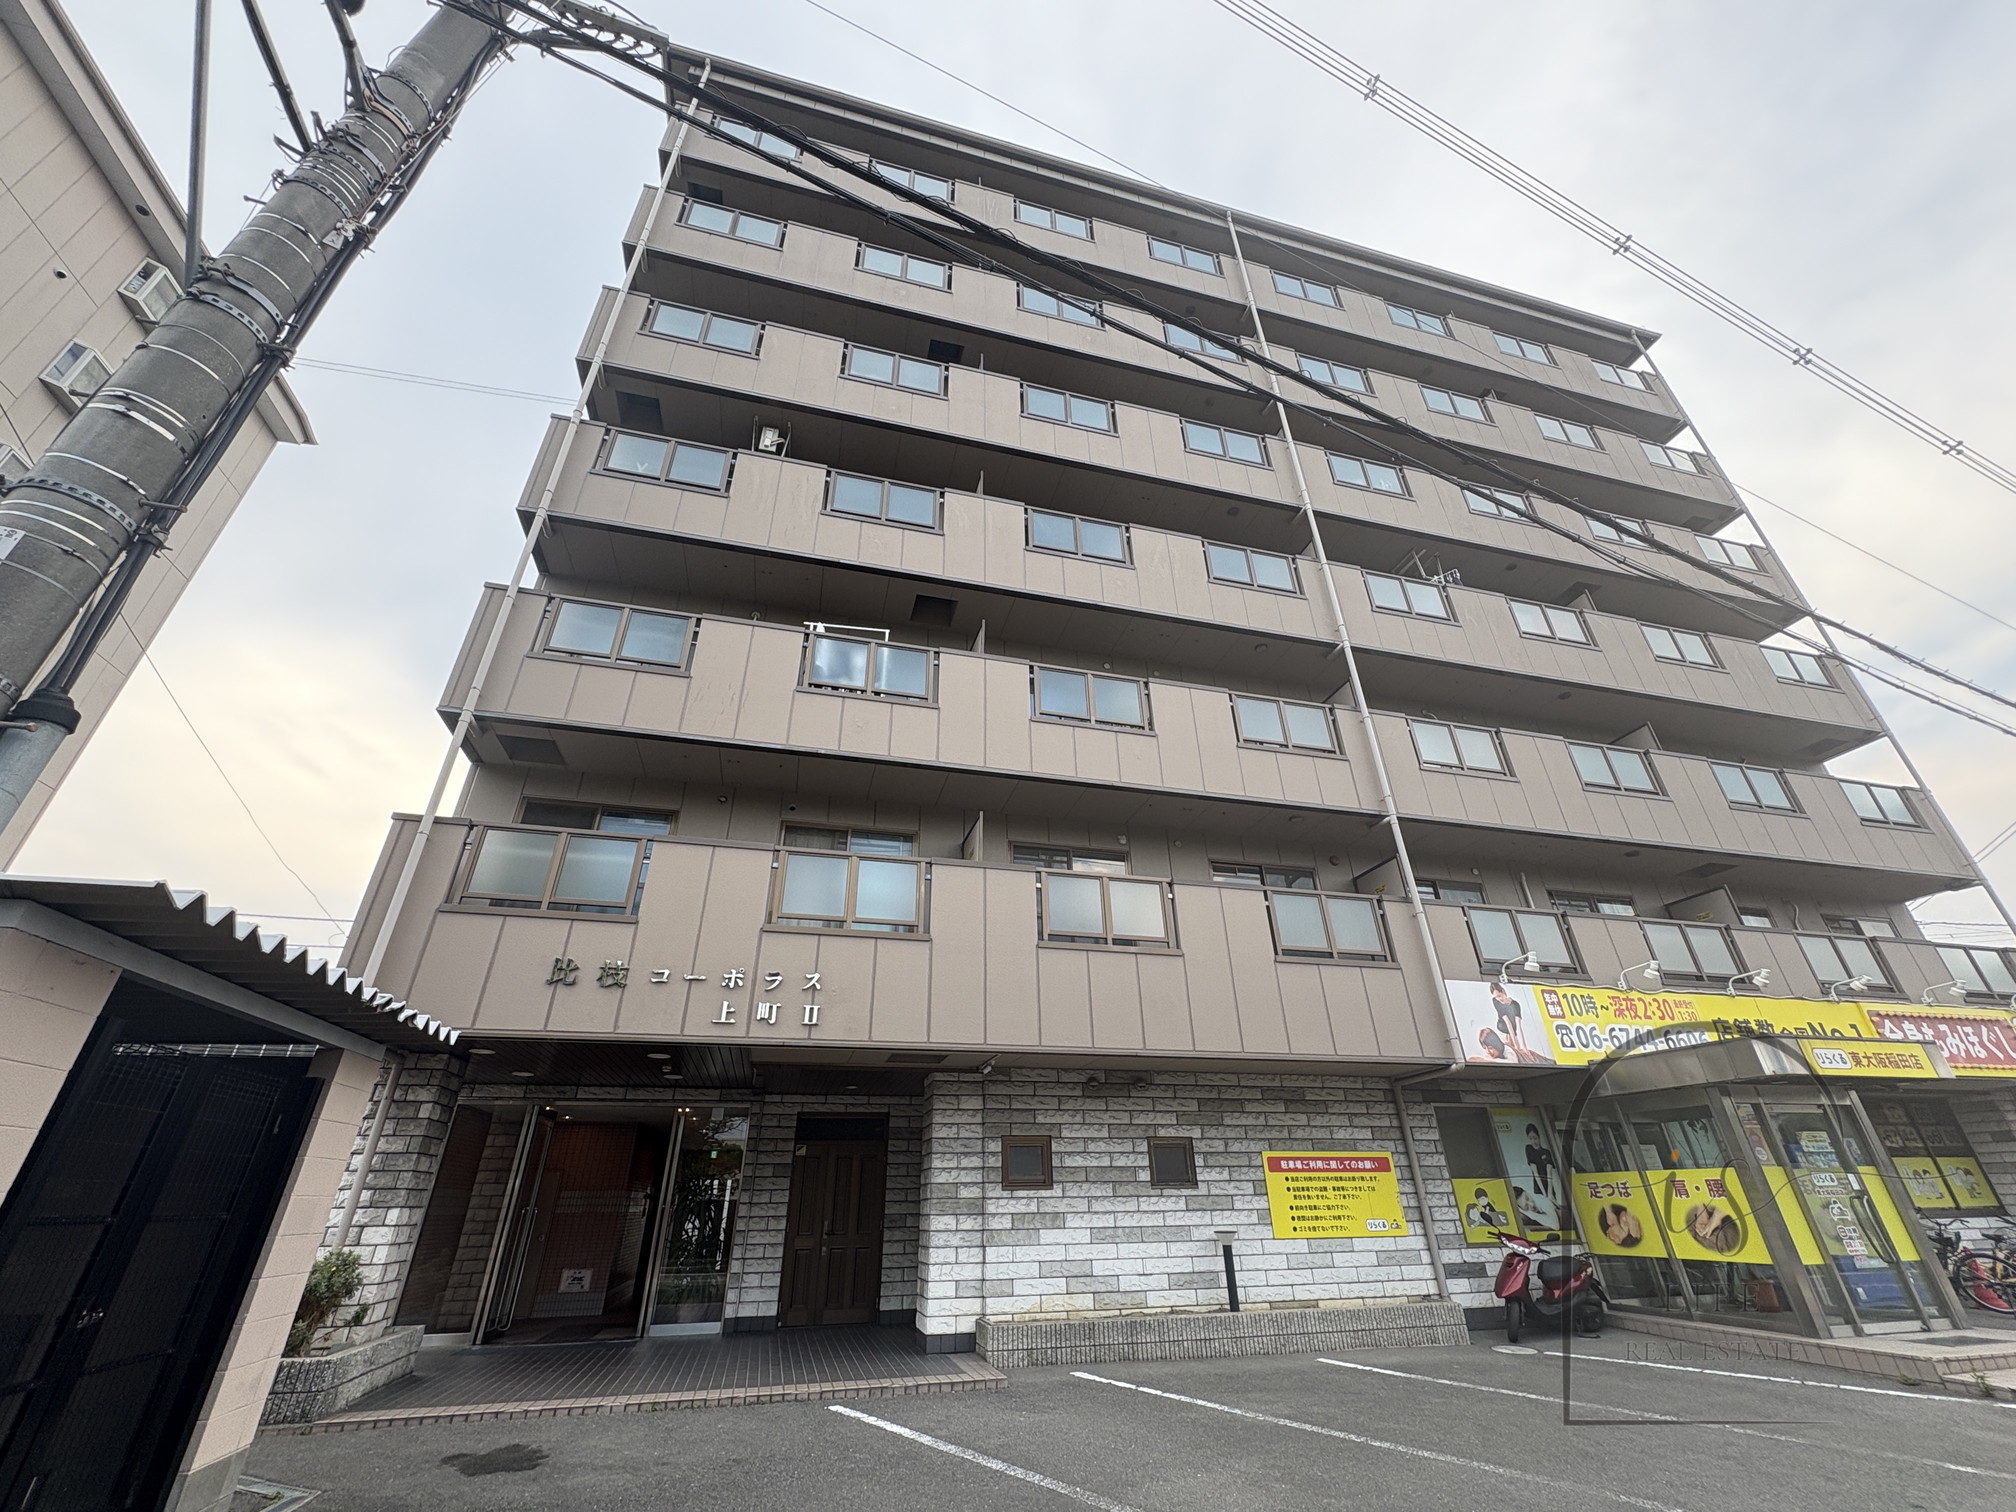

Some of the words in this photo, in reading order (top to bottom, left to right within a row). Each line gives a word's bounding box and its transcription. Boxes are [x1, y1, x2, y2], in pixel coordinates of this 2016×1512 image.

[1678, 1011, 1698, 1021] 1:30
[1815, 1052, 1848, 1065] りらくる
[1848, 1051, 1925, 1070] 東大阪稲田店
[1587, 1180, 1632, 1199] 足つぼ
